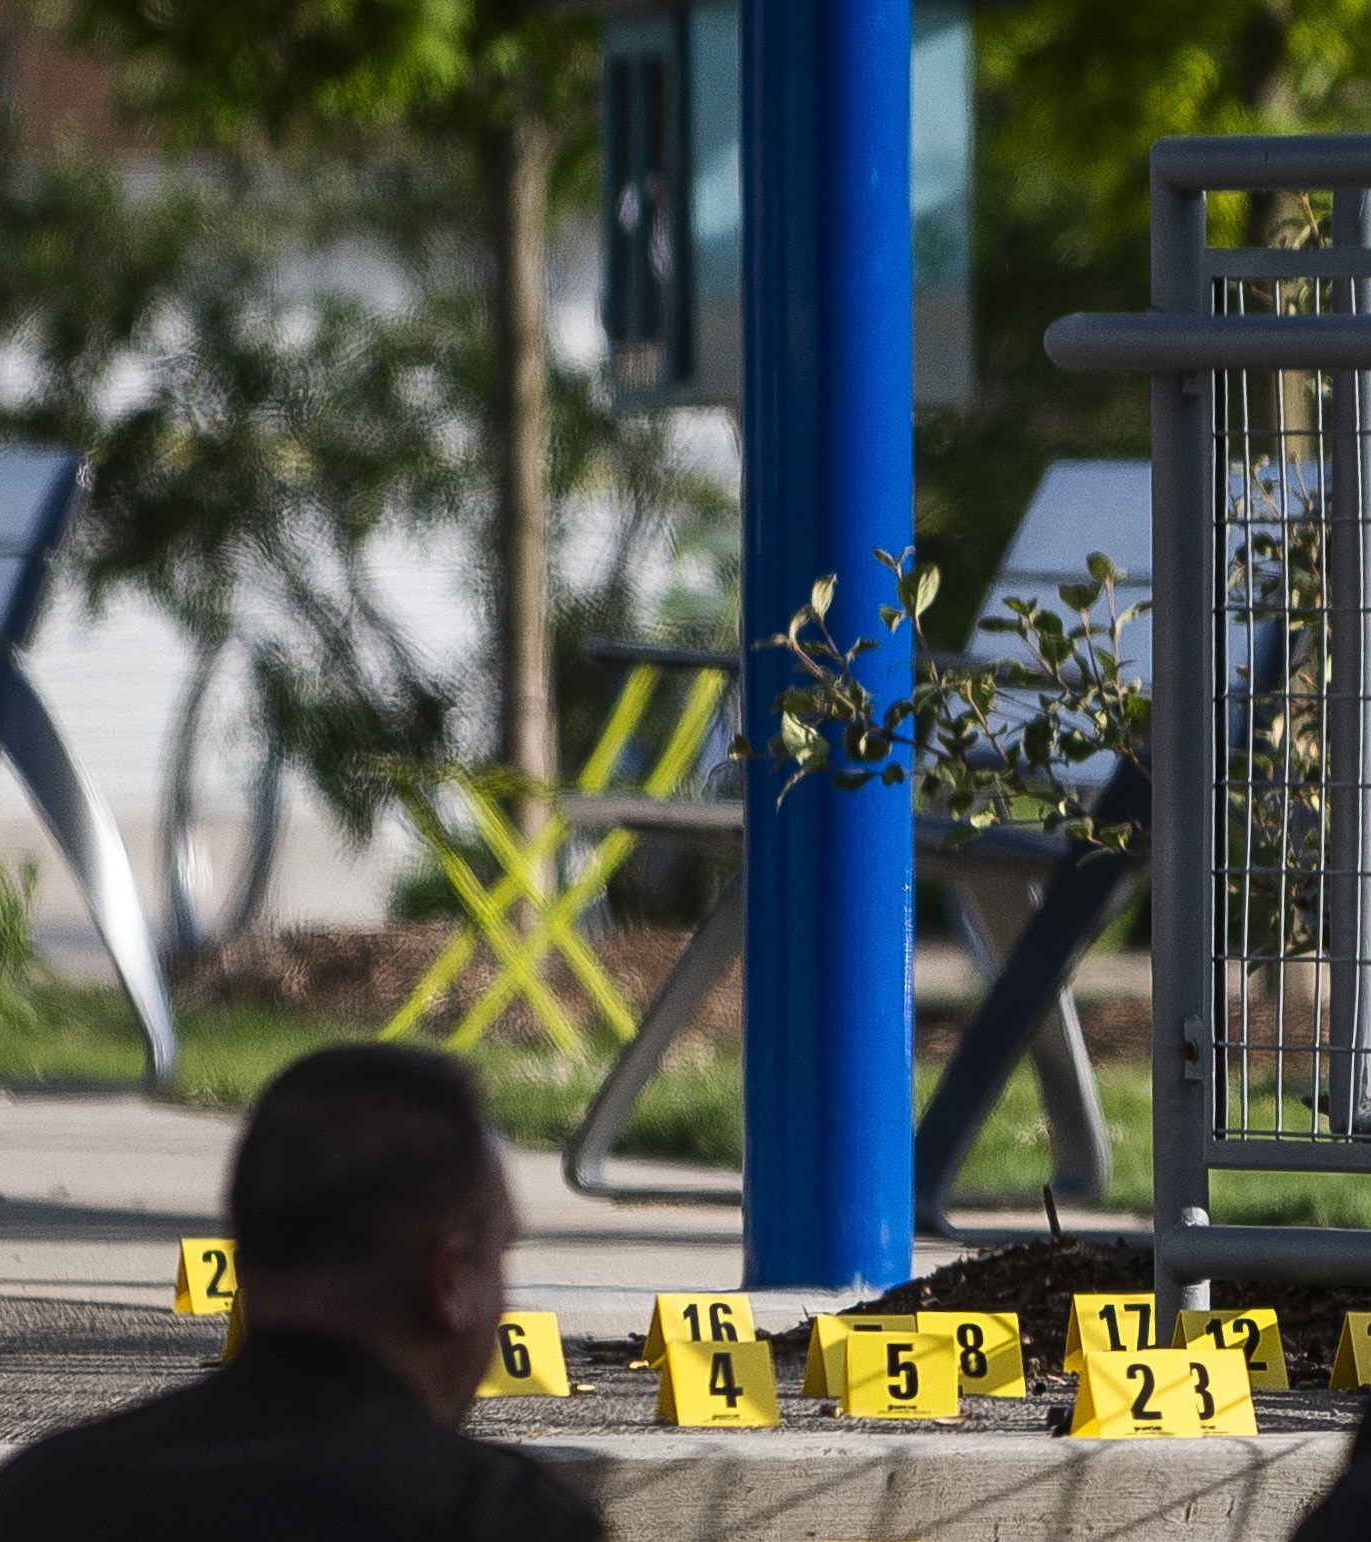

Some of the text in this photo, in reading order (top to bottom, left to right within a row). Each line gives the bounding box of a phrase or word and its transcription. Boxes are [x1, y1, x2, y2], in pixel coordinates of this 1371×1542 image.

[201, 1249, 234, 1299] 2
[683, 1302, 738, 1342] 16
[1099, 1303, 1152, 1351] 17
[1205, 1317, 1268, 1371] 12
[497, 1322, 532, 1379] 6
[886, 1342, 919, 1400] 5
[957, 1323, 988, 1379] 8
[709, 1352, 744, 1408] 4
[1126, 1363, 1163, 1421] 2
[1189, 1362, 1216, 1421] 3
